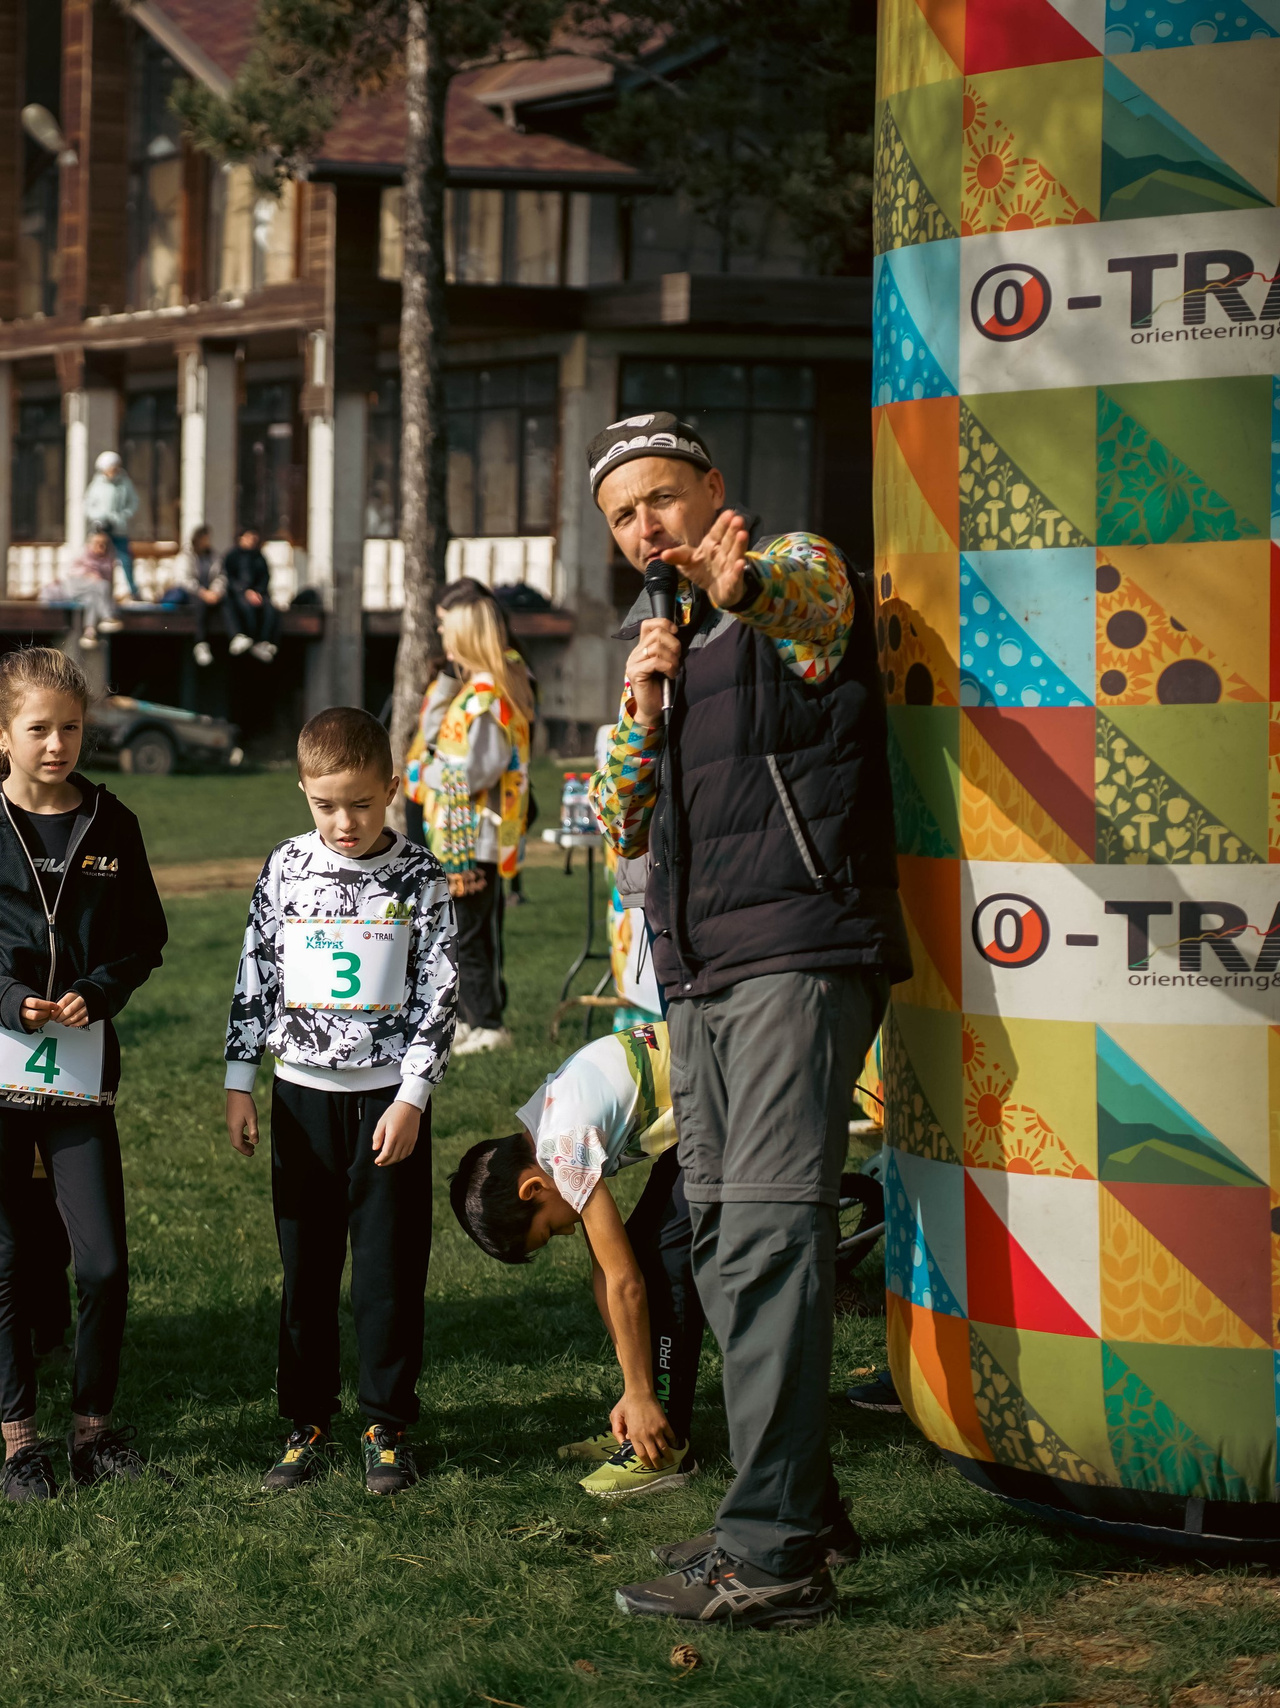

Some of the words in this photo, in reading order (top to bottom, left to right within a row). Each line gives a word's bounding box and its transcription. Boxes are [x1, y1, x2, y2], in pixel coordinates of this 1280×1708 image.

[1131, 321, 1280, 345] orienteering
[82, 855, 118, 871] FILA
[331, 952, 361, 998] 3
[25, 1036, 60, 1084] 4
[660, 1336, 672, 1369] PRO
